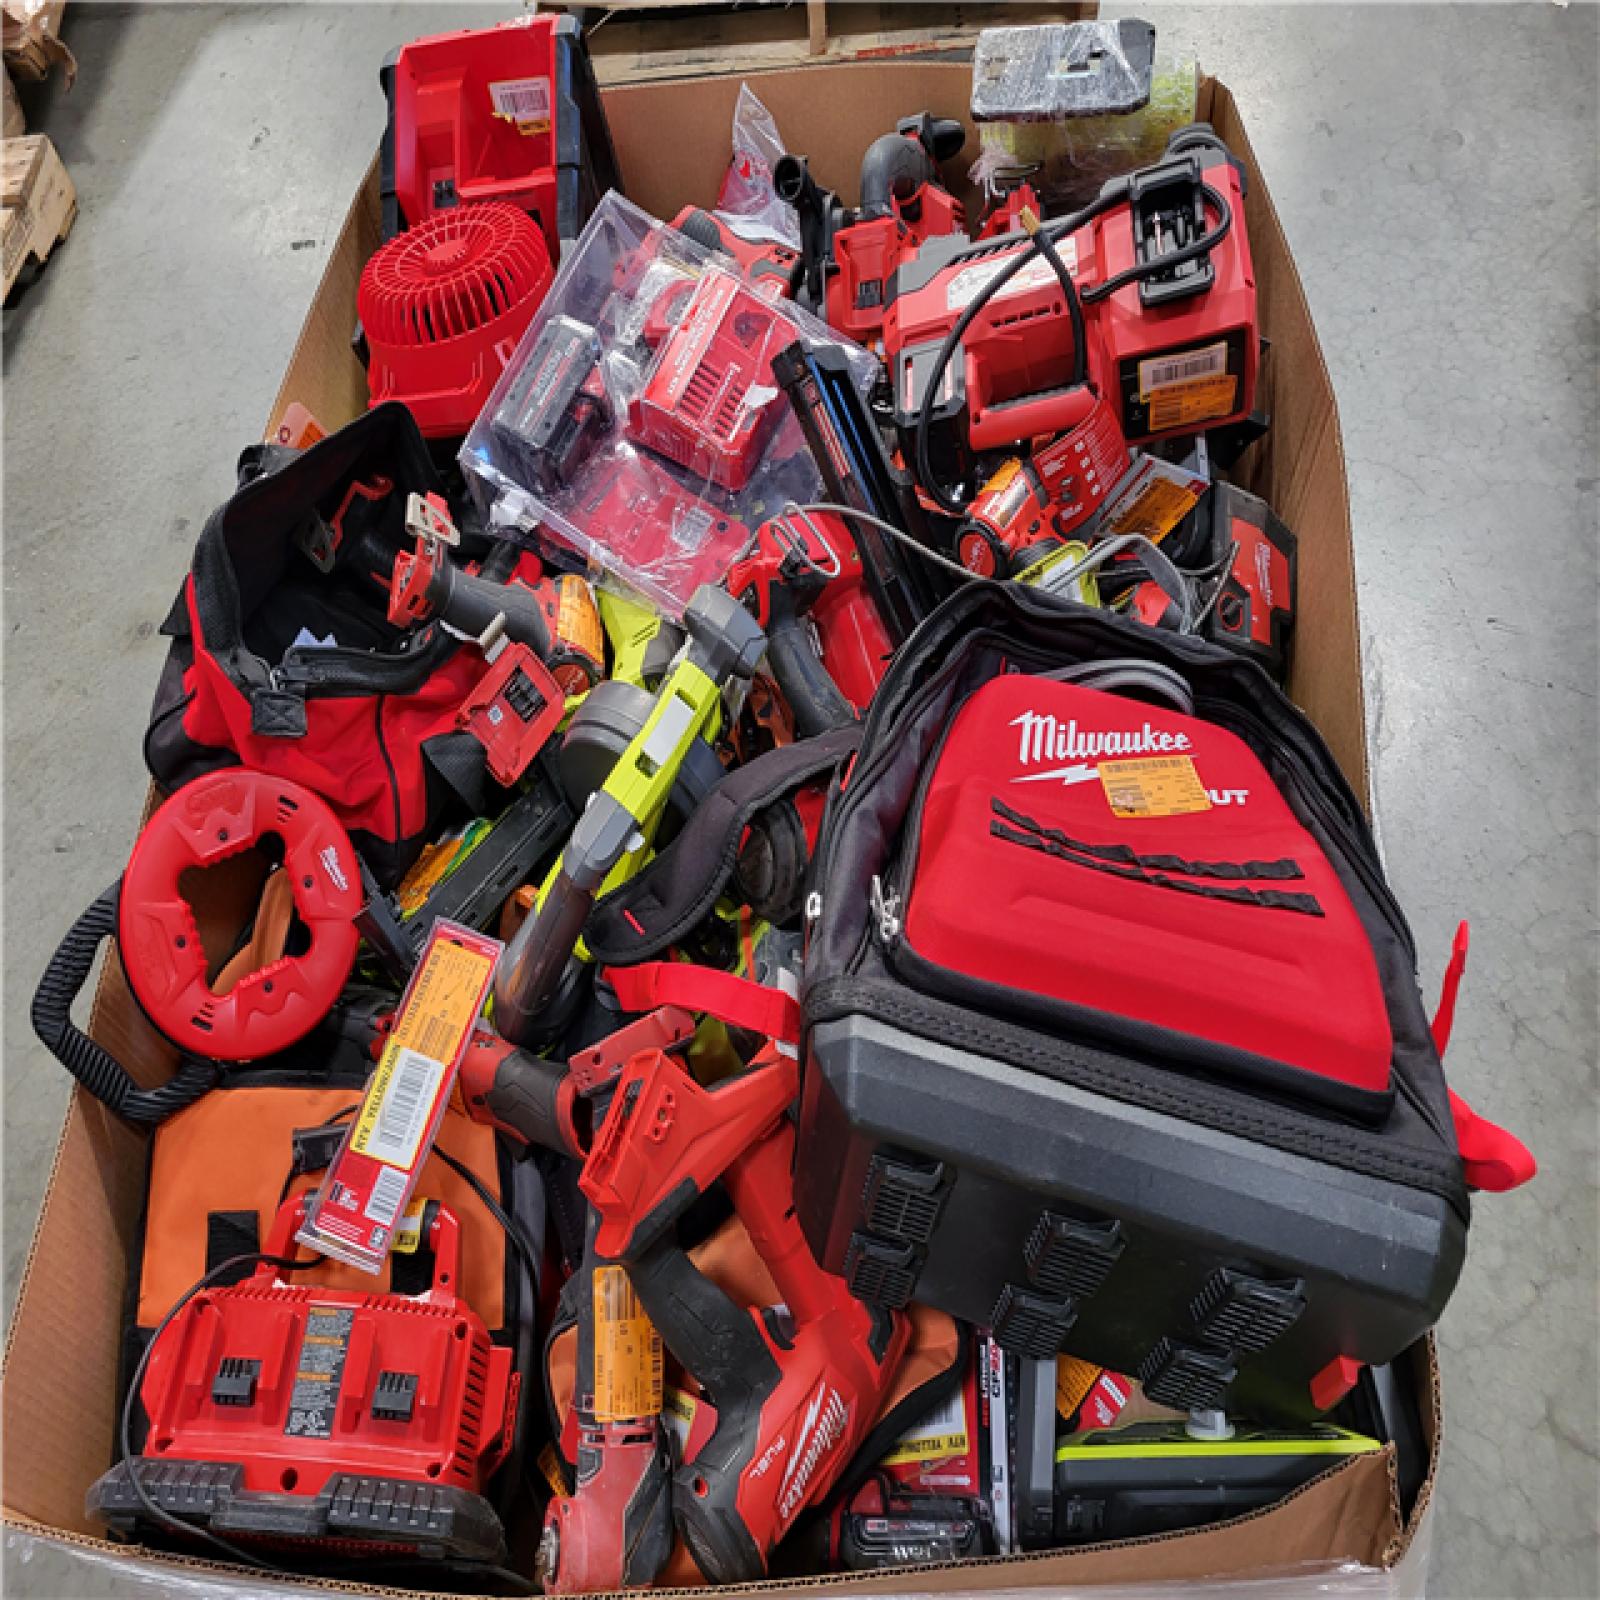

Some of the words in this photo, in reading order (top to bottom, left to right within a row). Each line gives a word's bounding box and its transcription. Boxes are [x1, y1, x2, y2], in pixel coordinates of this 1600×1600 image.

[1008, 710, 1192, 765] Milwaukee
[749, 1438, 786, 1479] FUEL
[783, 1389, 850, 1518] Milwaukee
